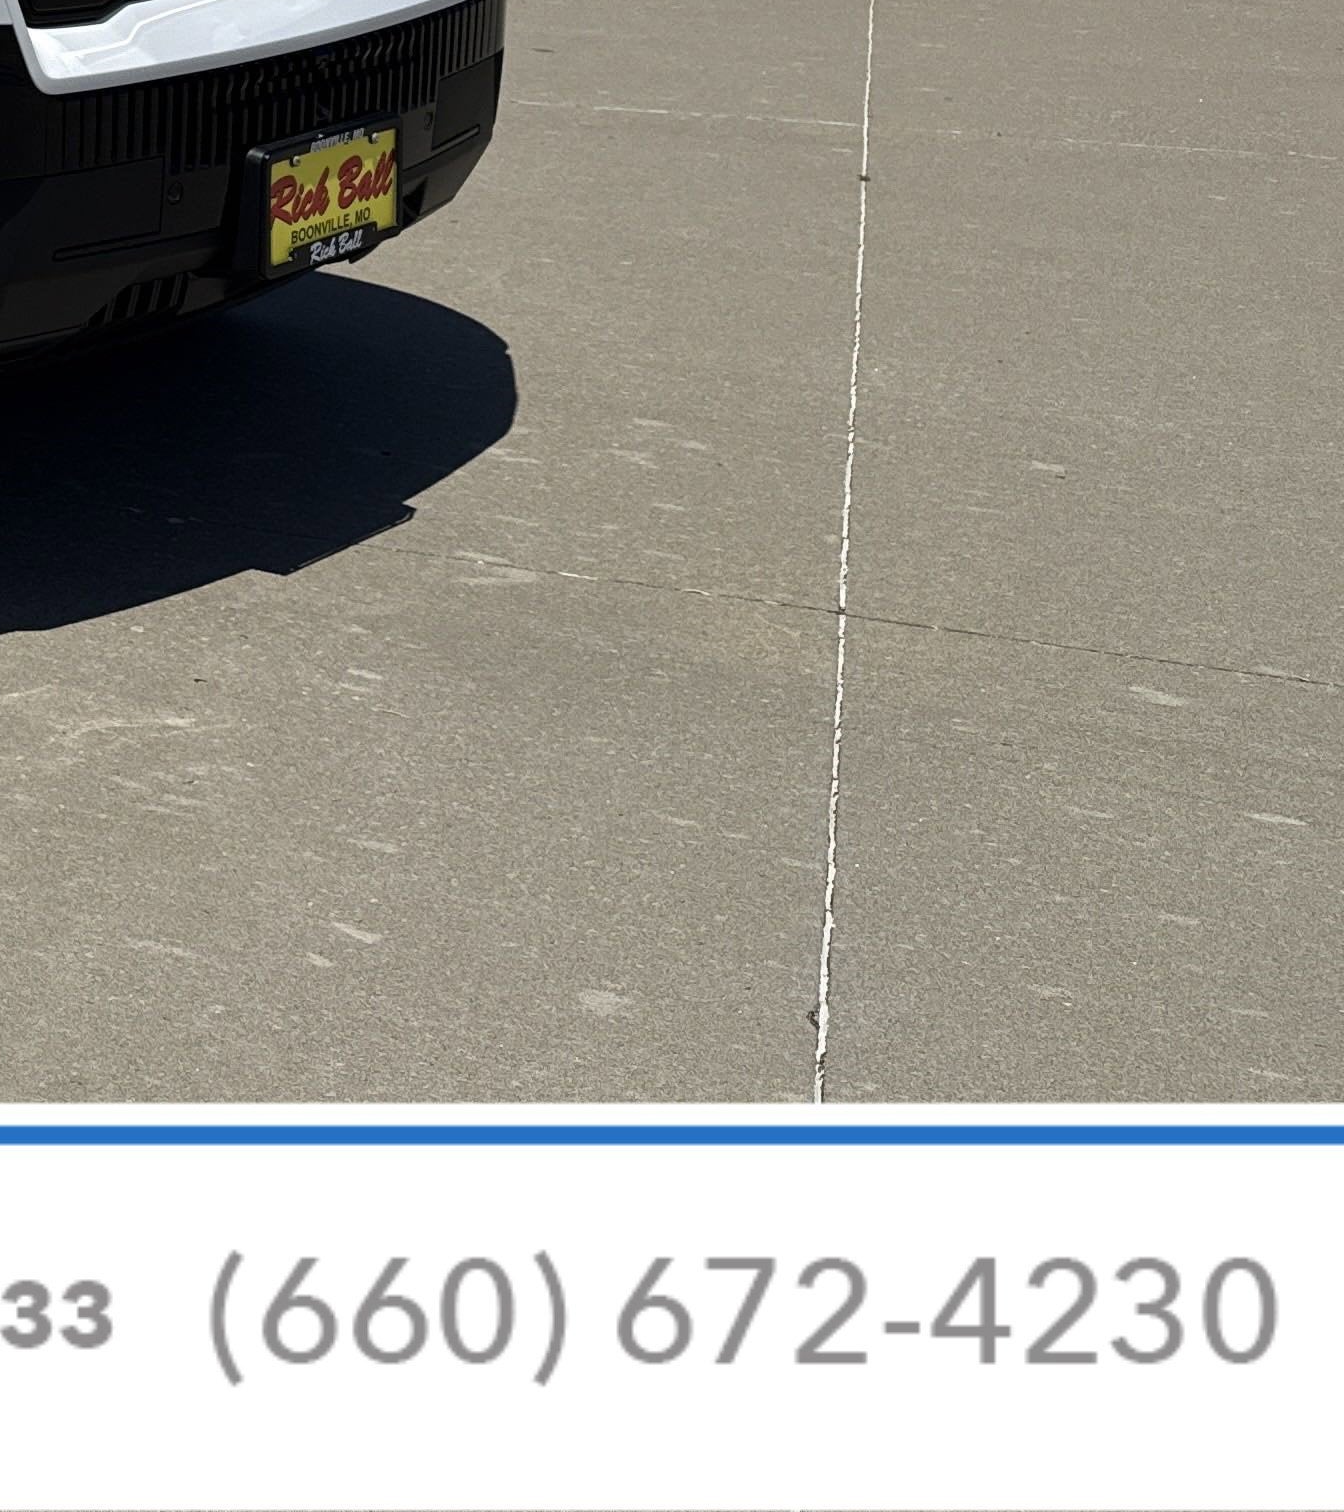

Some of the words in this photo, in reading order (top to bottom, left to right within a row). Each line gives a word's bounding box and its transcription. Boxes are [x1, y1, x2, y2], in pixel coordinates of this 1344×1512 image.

[270, 166, 330, 227] Rick
[337, 147, 396, 209] Ball
[291, 212, 353, 244] BOONVILLE,
[355, 207, 372, 225] MO
[309, 238, 337, 265] Rick
[338, 229, 363, 253] Ball
